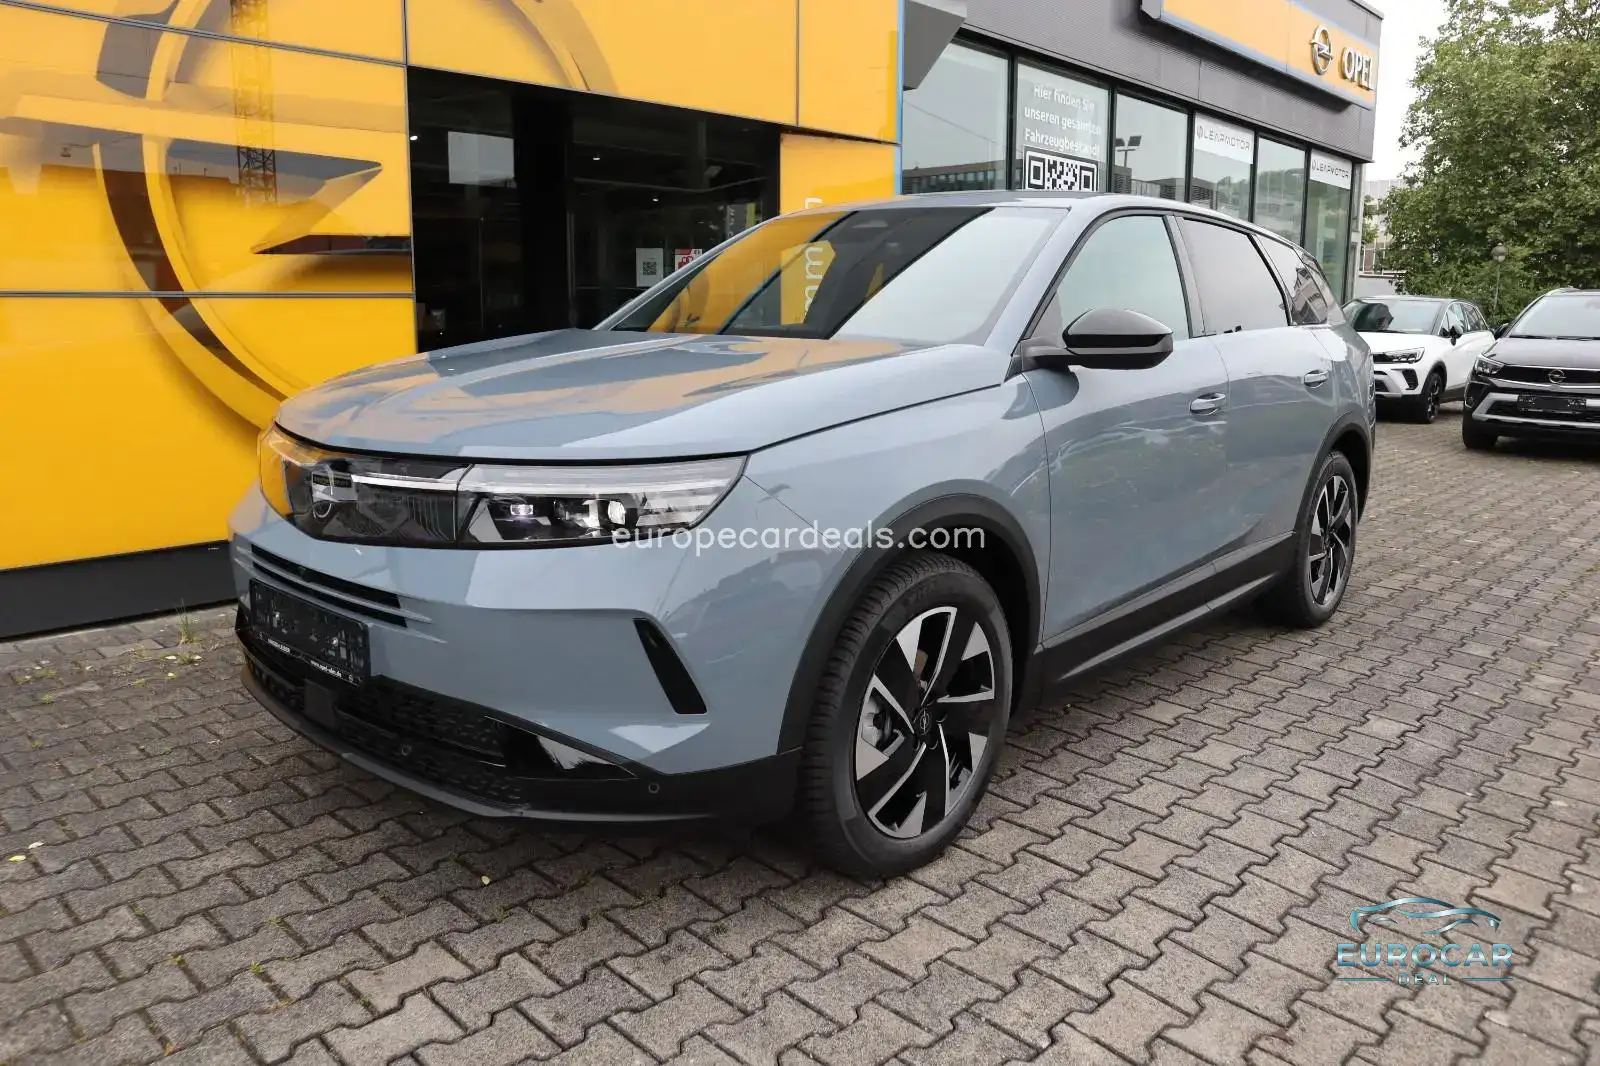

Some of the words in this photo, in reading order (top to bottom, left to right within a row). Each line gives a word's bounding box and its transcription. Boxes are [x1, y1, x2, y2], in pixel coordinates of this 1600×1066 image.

[1340, 47, 1376, 91] OPEL
[1033, 85, 1052, 101] Hier
[1054, 90, 1081, 108] finden
[1024, 106, 1060, 125] unseren
[1061, 117, 1101, 136] gesamten
[1203, 132, 1250, 152] LEAPMOTOR
[1315, 162, 1349, 179] LEAPMOTOR
